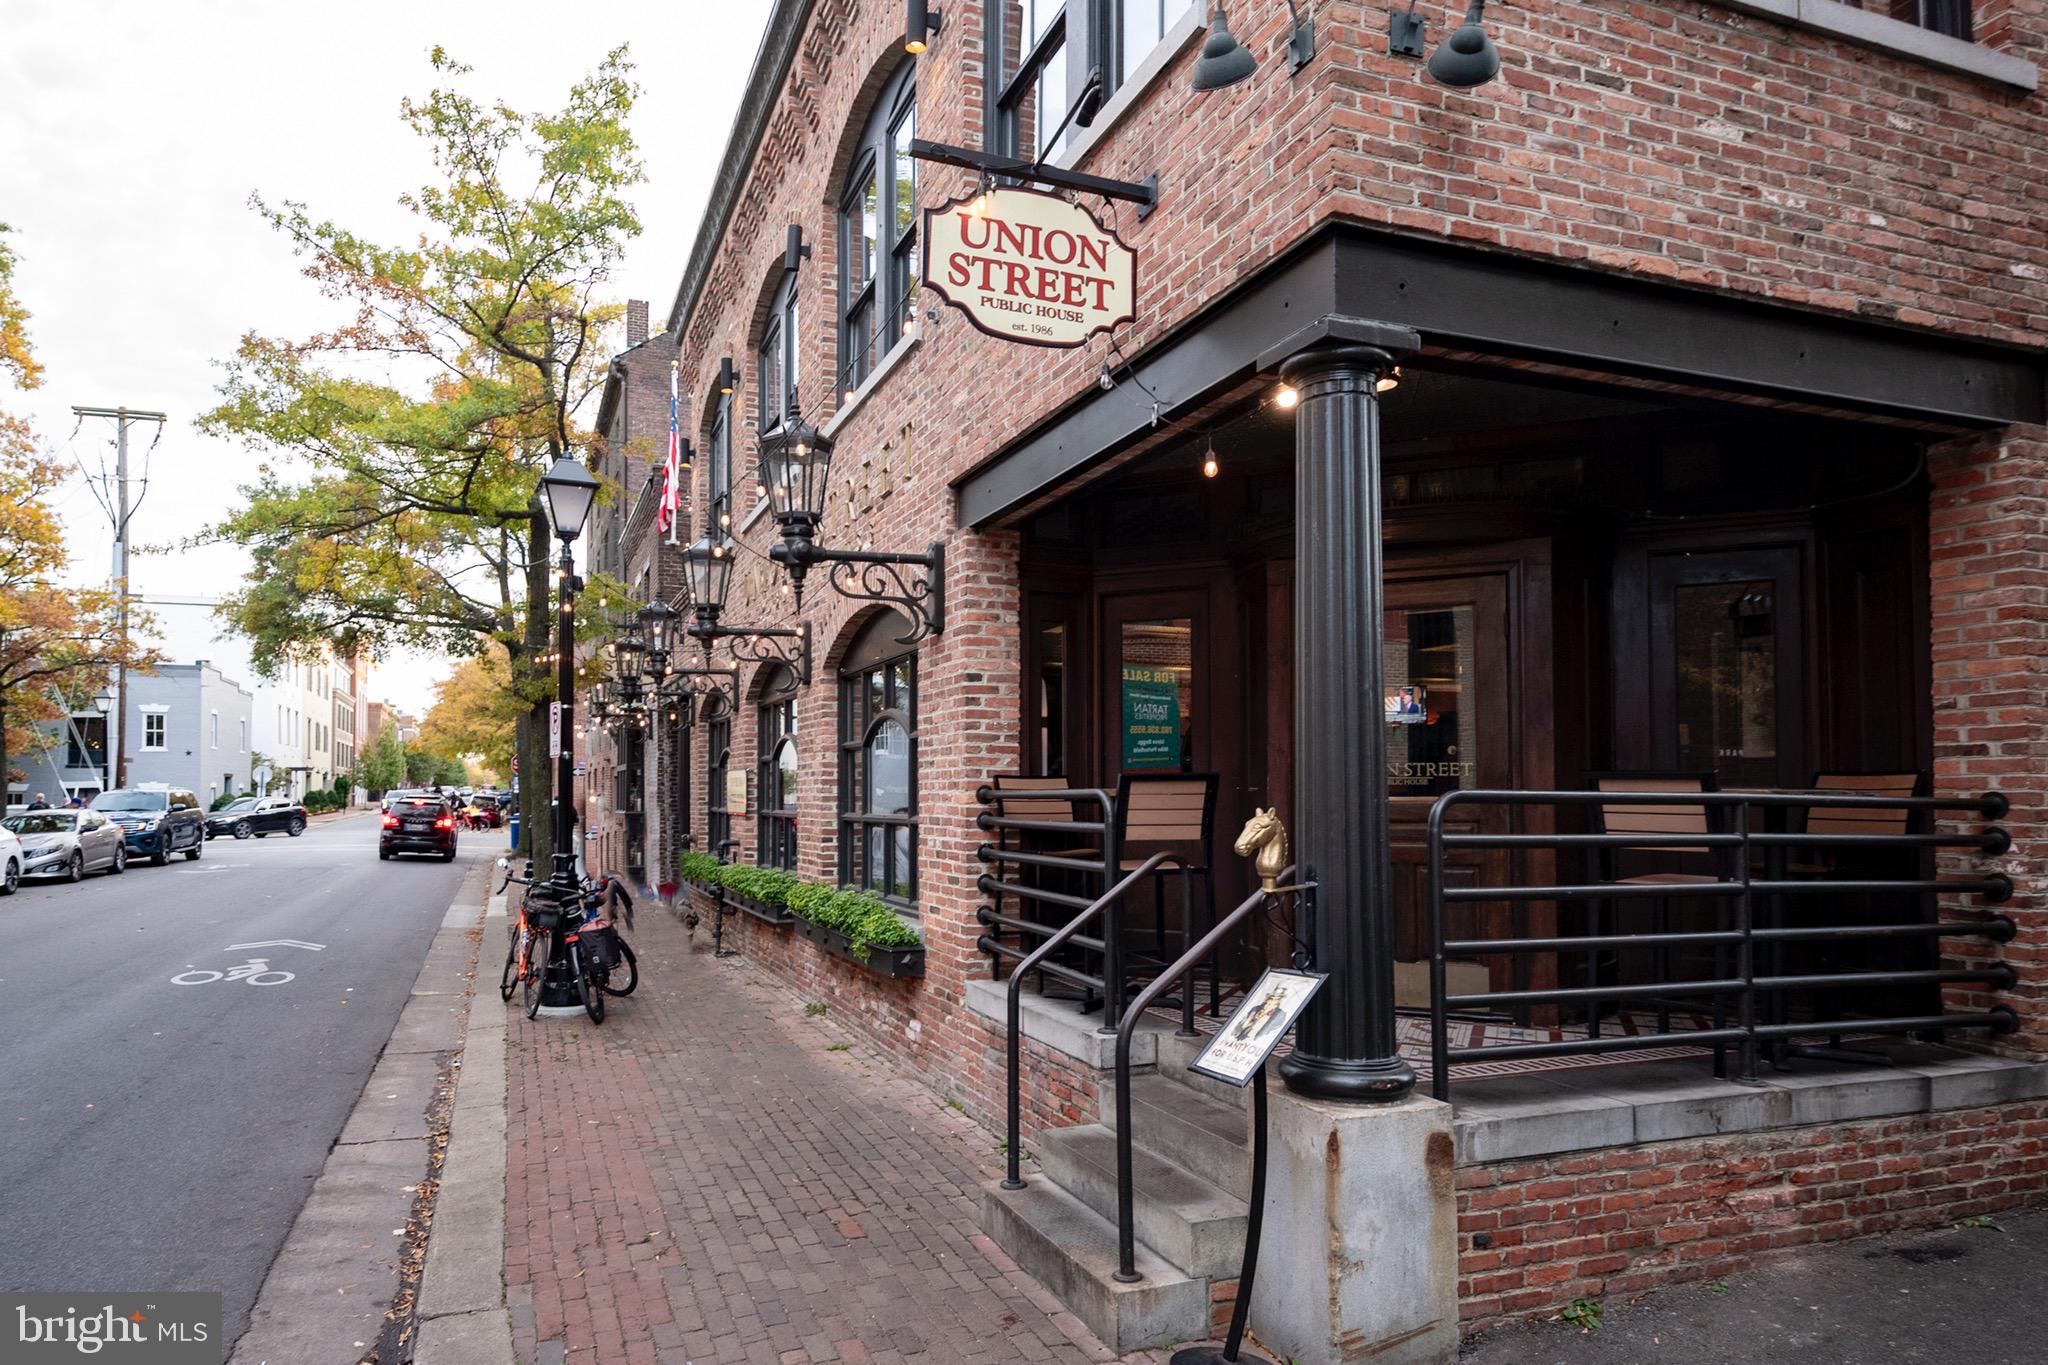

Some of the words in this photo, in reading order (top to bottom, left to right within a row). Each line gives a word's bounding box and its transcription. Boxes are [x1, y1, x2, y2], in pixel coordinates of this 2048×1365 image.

[957, 212, 1110, 272] UNION
[948, 252, 1115, 311] STREET
[980, 295, 1033, 316] PUBLIC
[1036, 305, 1085, 324] HOUSE
[1011, 321, 1028, 333] est.
[1031, 323, 1054, 336] 1986
[1404, 762, 1473, 777] STREET
